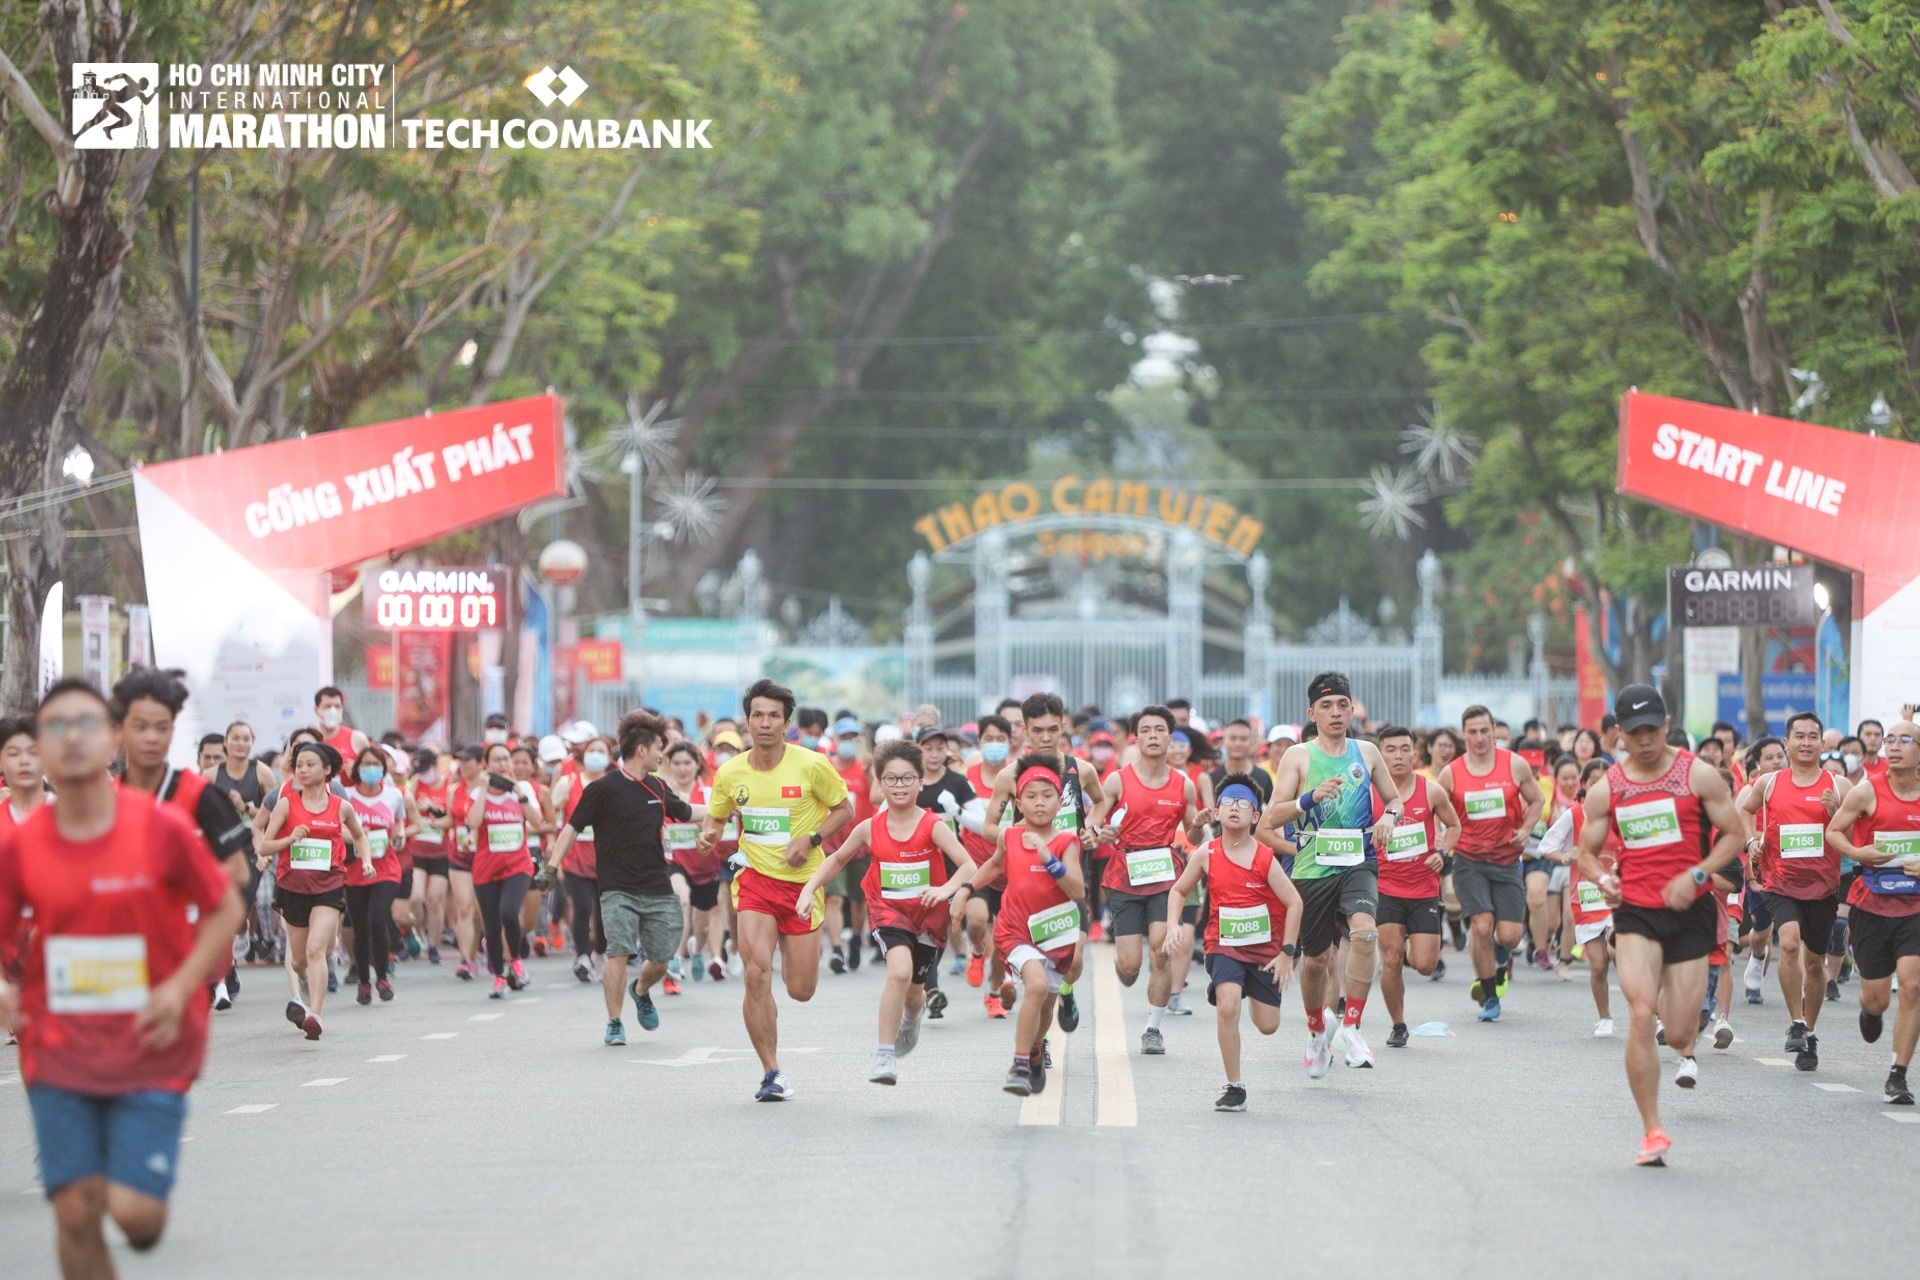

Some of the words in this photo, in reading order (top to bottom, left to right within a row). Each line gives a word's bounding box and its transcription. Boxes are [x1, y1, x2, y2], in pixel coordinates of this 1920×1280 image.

[344, 445, 436, 511] XUẤT
[441, 422, 534, 483] PHÁT
[1652, 423, 1764, 487] START
[1764, 459, 1847, 517] LINE
[378, 570, 489, 594] GARMIN
[1684, 570, 1792, 592] GARMIN
[751, 819, 780, 831] 7720
[1627, 817, 1669, 834] 36045
[1327, 841, 1355, 852] 7019
[1394, 837, 1419, 849] 7334
[1788, 836, 1815, 847] 7158
[1885, 842, 1913, 853] 7017
[299, 847, 322, 858] 7187
[1135, 861, 1167, 874] 34229
[890, 873, 921, 885] 7669
[1041, 915, 1074, 935] 7089
[1230, 920, 1260, 933] 7088
